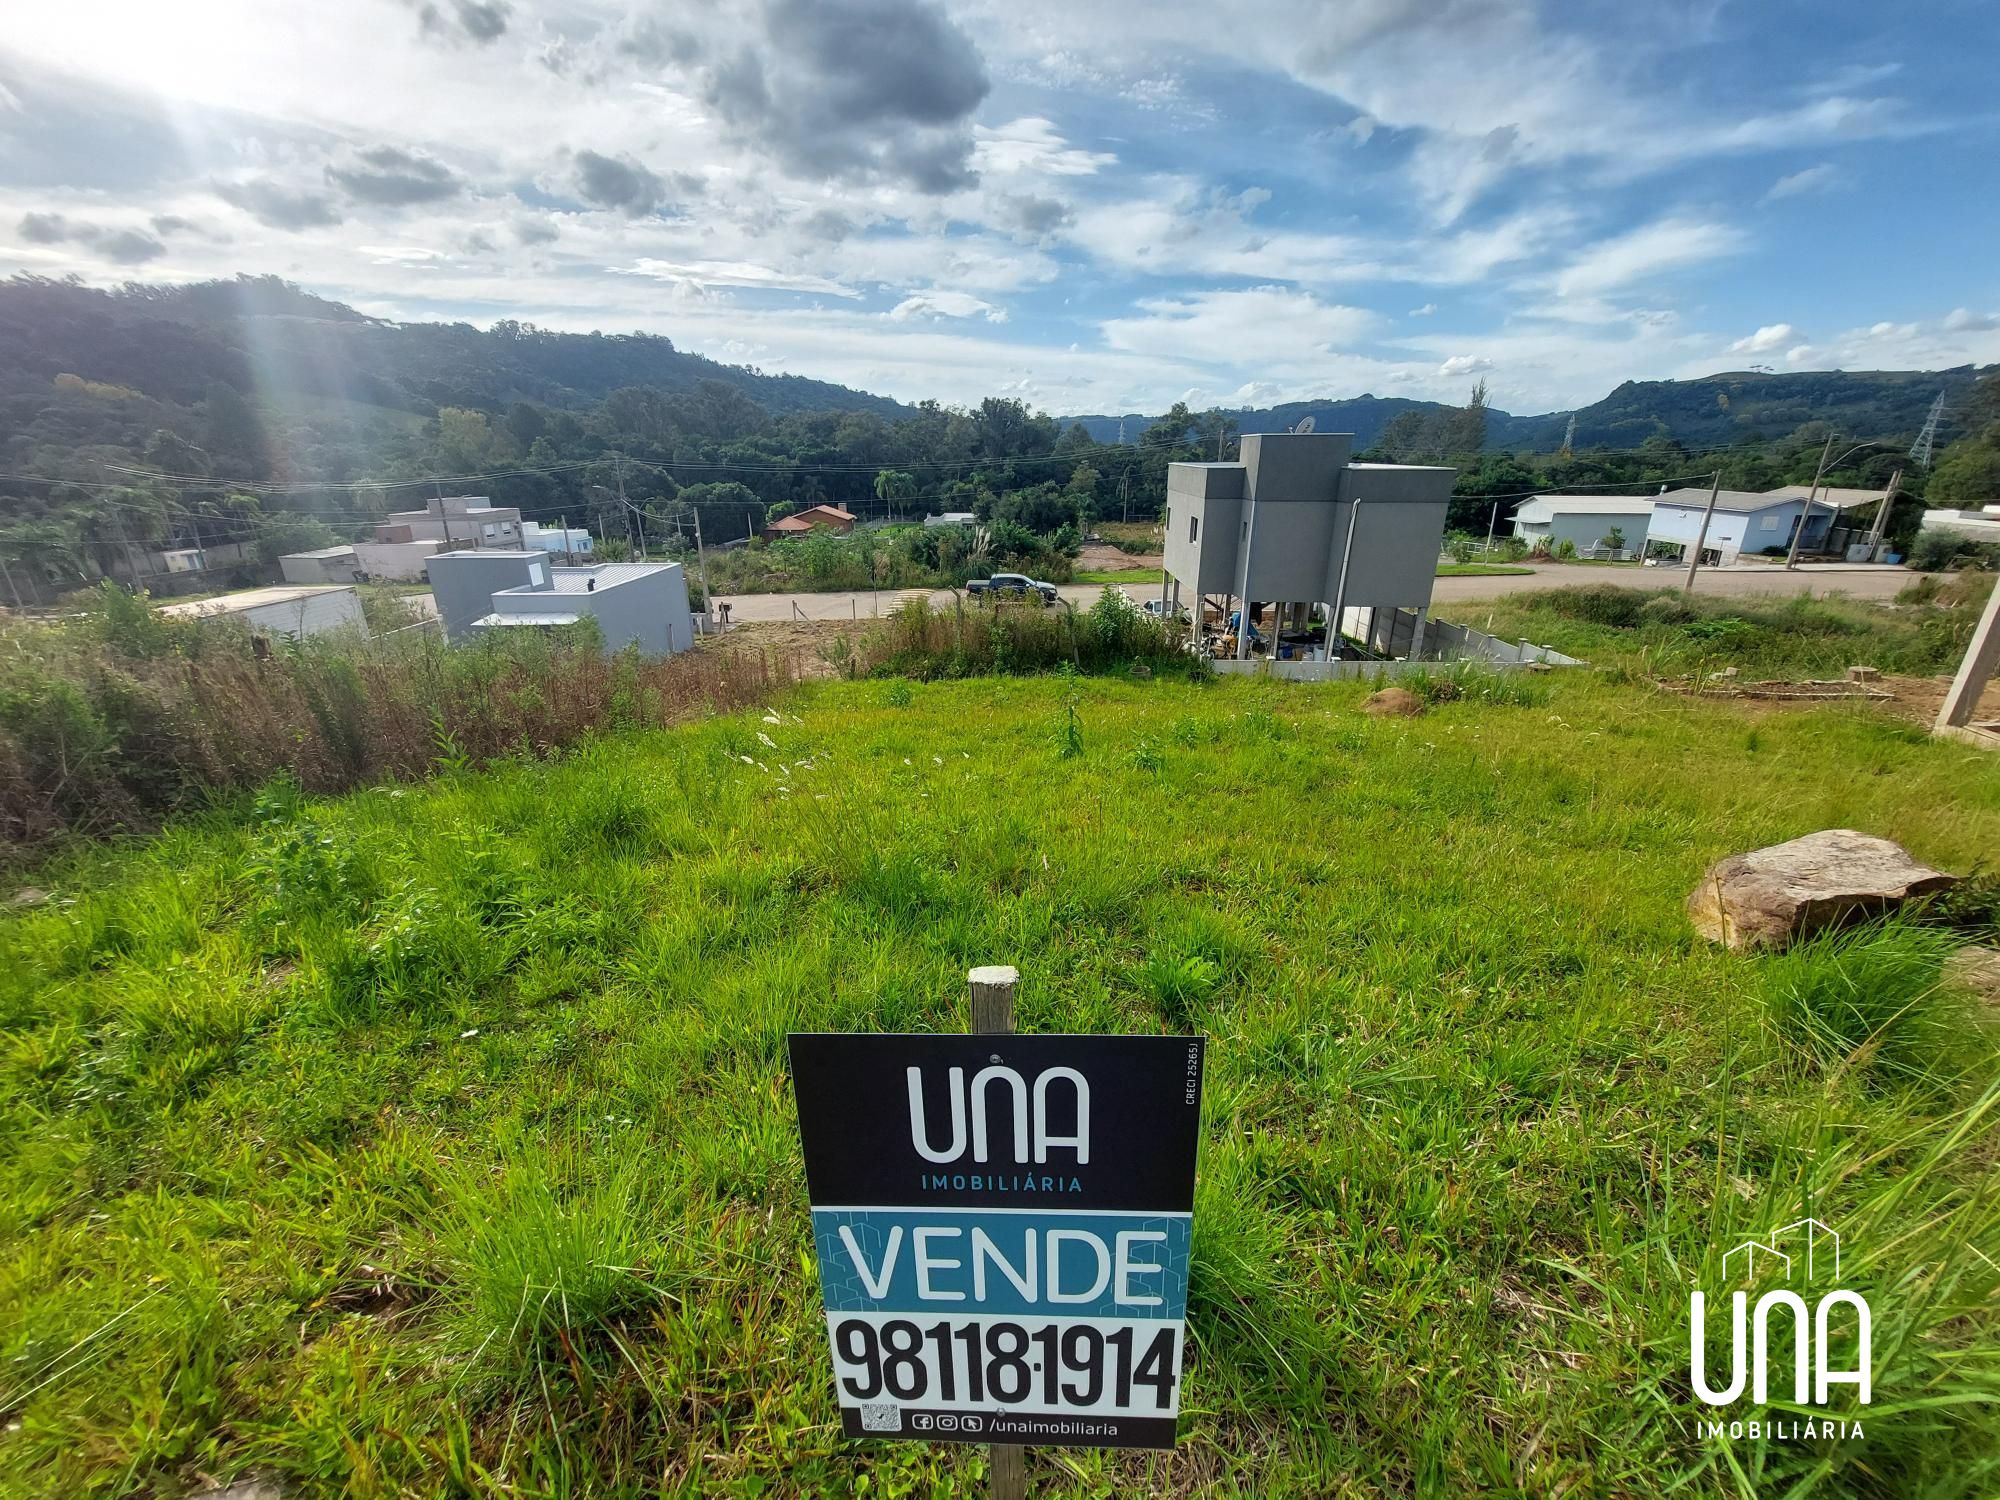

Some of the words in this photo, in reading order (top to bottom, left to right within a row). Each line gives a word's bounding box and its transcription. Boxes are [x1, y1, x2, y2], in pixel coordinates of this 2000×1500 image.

[1187, 1043, 1198, 1076] 25265J
[1185, 1079, 1196, 1105] CRECI
[906, 1066, 1090, 1164] UNA
[921, 1172, 1083, 1193] IMOBILIÁRIA
[838, 1225, 1168, 1306] VENDE
[989, 1418, 1118, 1436] /unaimobiliaria
